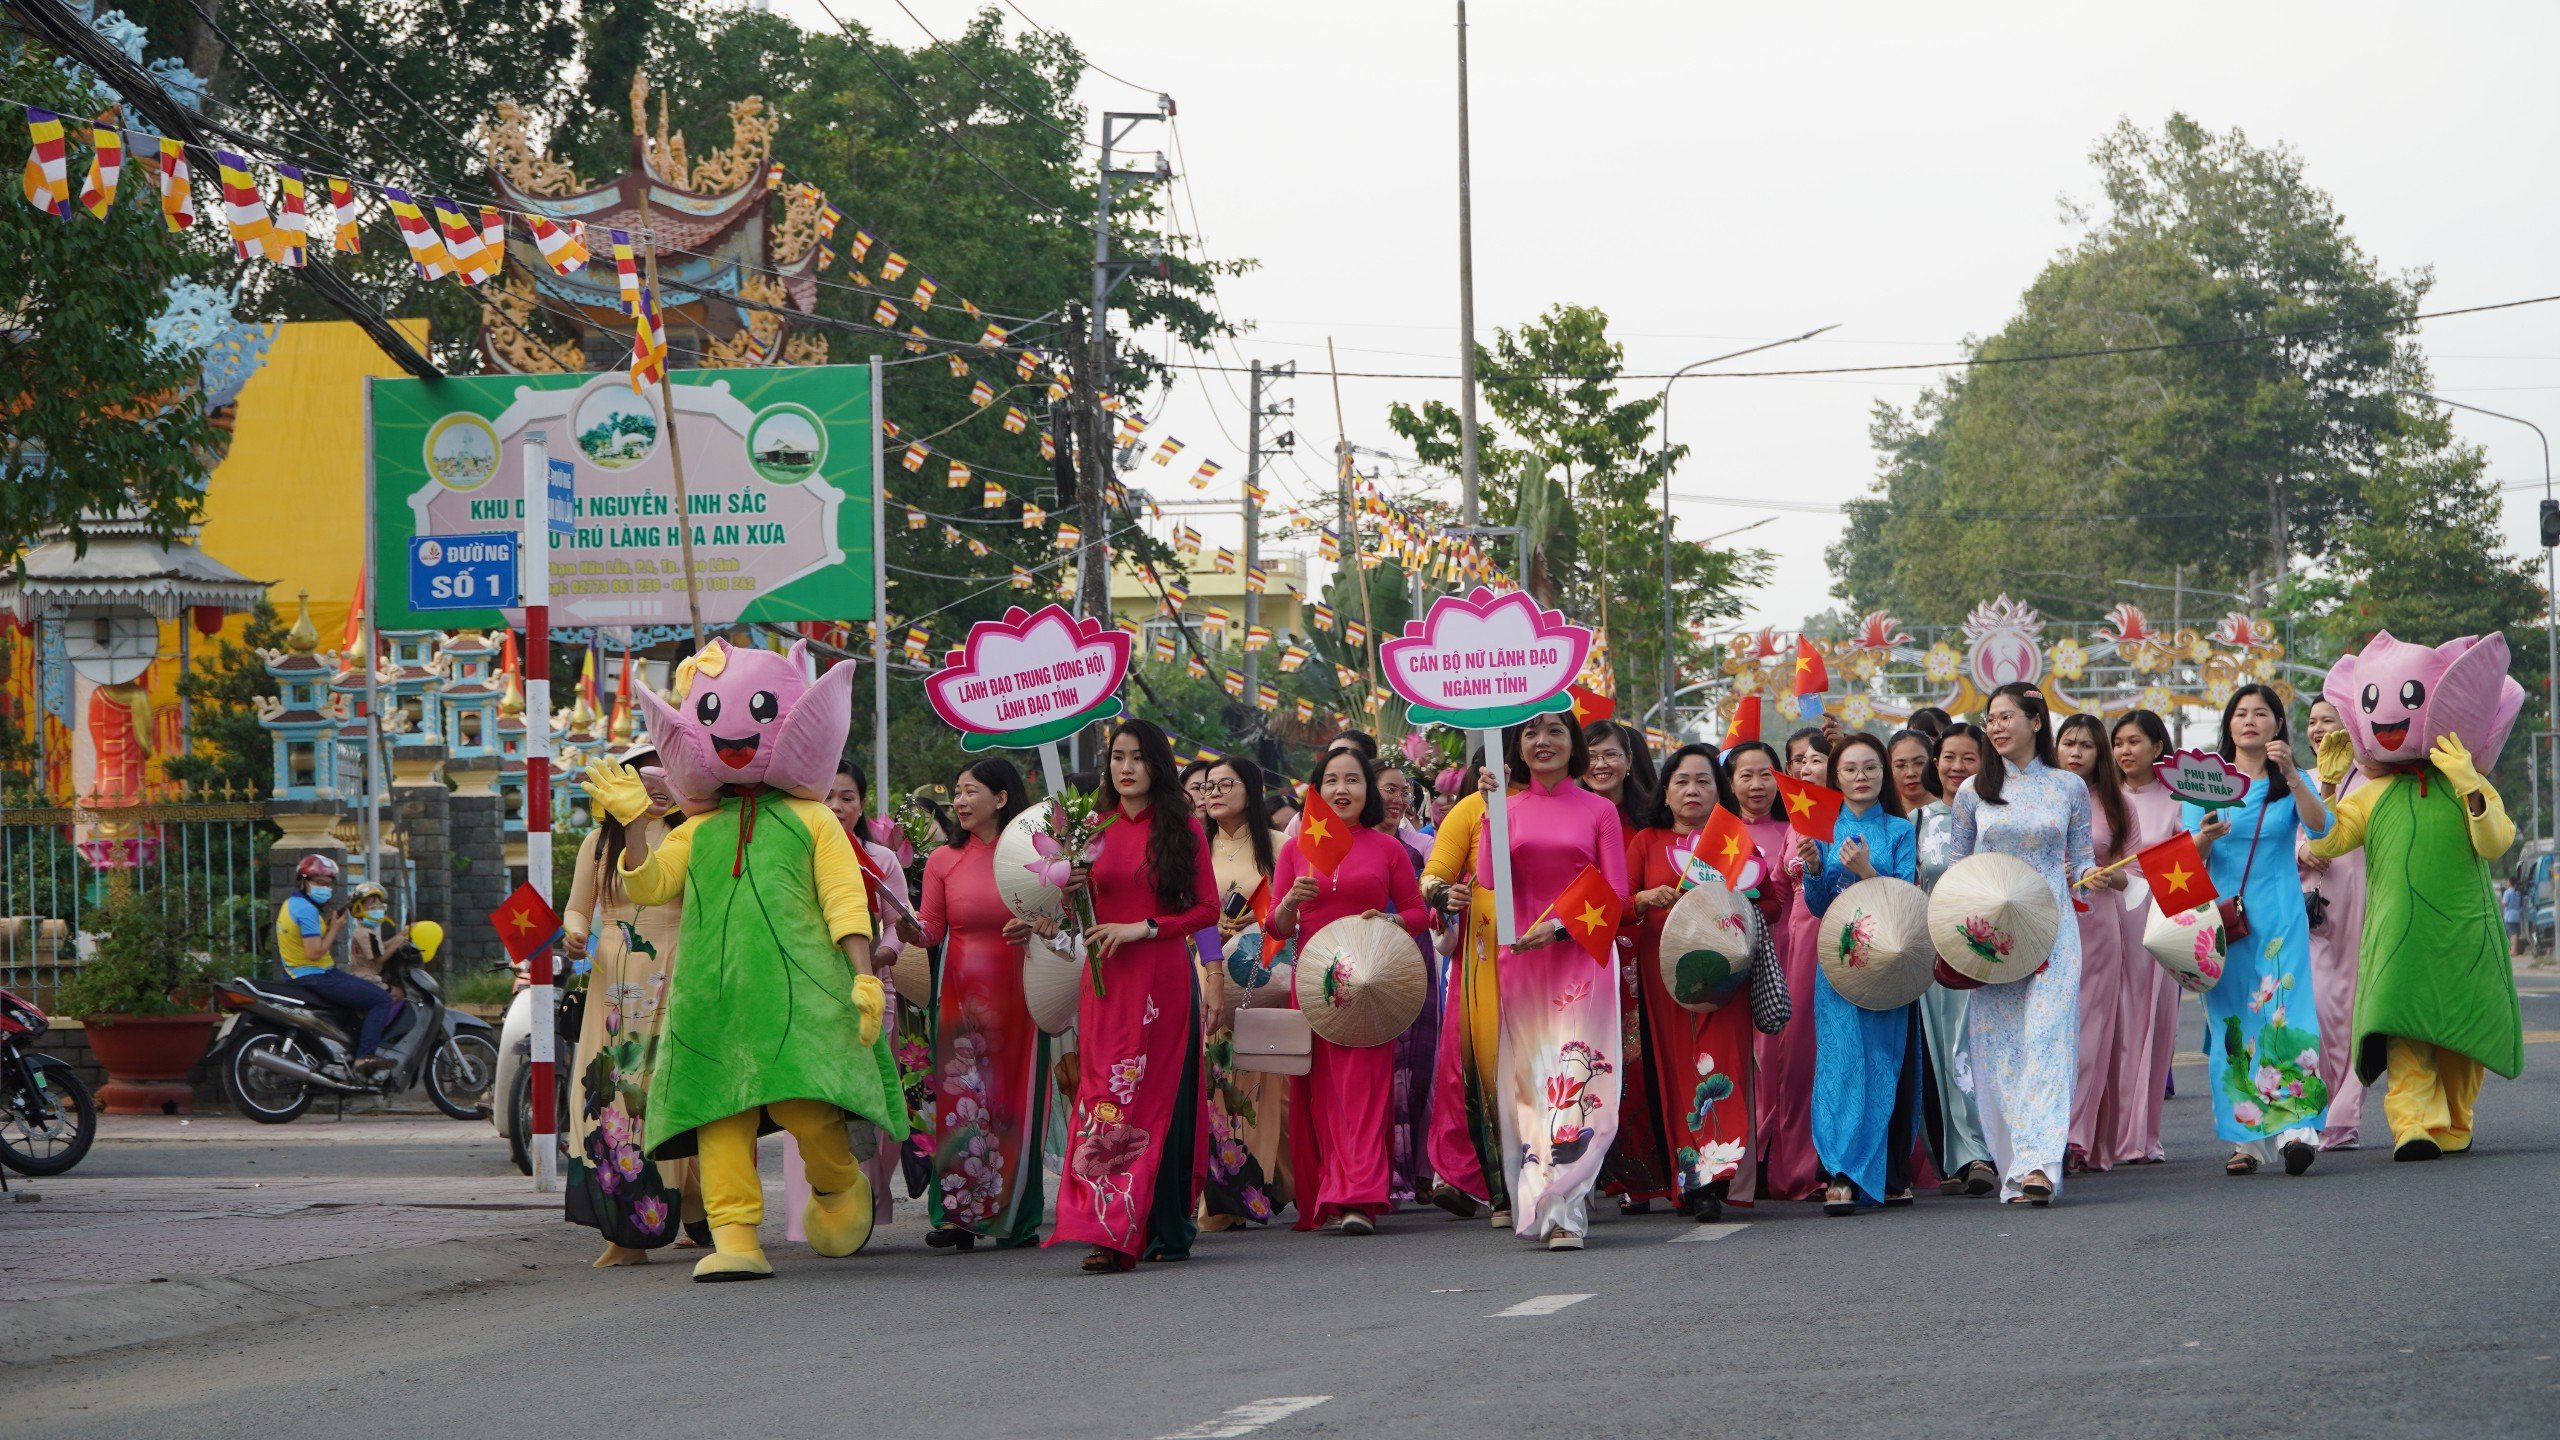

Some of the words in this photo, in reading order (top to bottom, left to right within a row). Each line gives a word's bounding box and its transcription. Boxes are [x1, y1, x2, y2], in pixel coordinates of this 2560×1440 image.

[471, 499, 509, 520] KHU
[590, 487, 667, 517] NGUYỄN
[727, 485, 767, 514] SẮC
[610, 522, 661, 548] LÀNG
[667, 525, 706, 547] HA
[712, 524, 740, 546] AN
[745, 522, 786, 545] XƯA
[447, 542, 510, 563] ĐƯỜNG
[431, 567, 474, 599] SỐ
[485, 574, 500, 596] 1
[1409, 652, 1439, 672] CÁN
[1442, 650, 1461, 674] BỘ
[1465, 649, 1486, 669] NỮ
[1489, 647, 1526, 668] LÃNH
[1529, 647, 1558, 669] ĐẠO
[958, 680, 989, 703] LÃNH
[989, 675, 1013, 698] ĐẠO
[1013, 666, 1052, 691] TRUNG
[1052, 659, 1085, 682] ƯƠNG
[1084, 651, 1106, 677] HỘI
[1442, 676, 1492, 697] NGÀNH
[1495, 671, 1527, 694] TỈNH
[996, 699, 1027, 721] LÃNH
[1027, 693, 1051, 717] ĐẠO
[1051, 684, 1079, 709] TỈNH
[2177, 779, 2206, 792] ĐỒNG
[2208, 784, 2234, 796] THÁP
[2183, 768, 2205, 782] PHỤ
[2206, 771, 2223, 783] NỮ
